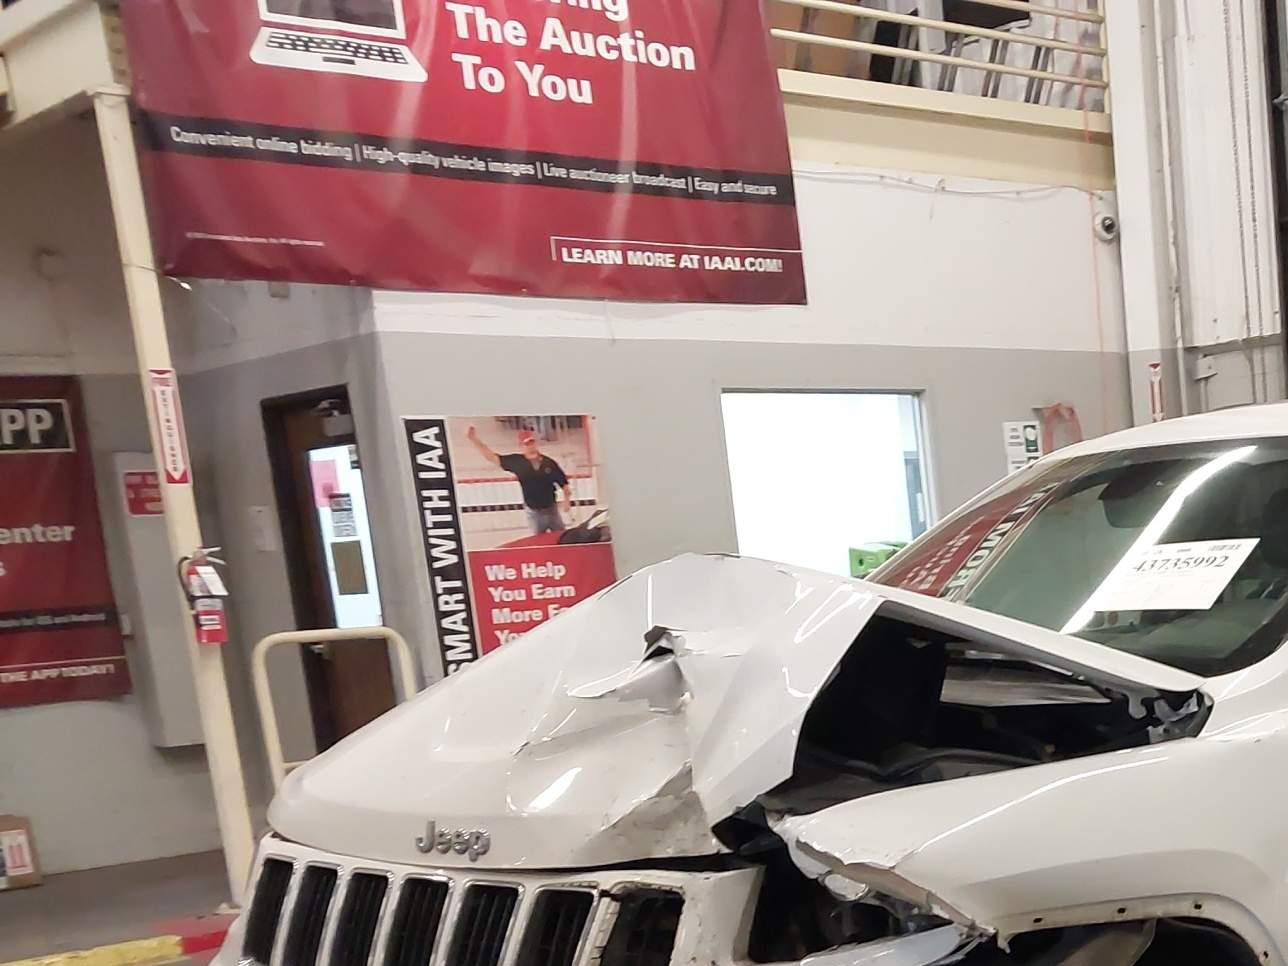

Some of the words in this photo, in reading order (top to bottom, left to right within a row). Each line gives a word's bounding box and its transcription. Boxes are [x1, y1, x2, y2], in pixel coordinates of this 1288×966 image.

[445, 2, 528, 47] The
[539, 17, 696, 71] Auction
[451, 52, 506, 93] To
[514, 60, 593, 105] You
[487, 158, 535, 177] images
[543, 162, 568, 178] Live
[694, 177, 719, 194] Easy
[561, 247, 623, 264] LEARN
[627, 250, 676, 268] MORE
[679, 254, 700, 269] AT
[703, 255, 784, 273] IAAI.COM!
[0, 408, 54, 445] PP
[412, 426, 447, 479] IAA
[420, 489, 459, 569] WITH
[484, 564, 517, 581] We
[520, 561, 567, 580] Help
[1131, 555, 1230, 573] 43735992
[487, 586, 527, 602] You
[531, 583, 576, 600] Earn
[491, 607, 543, 624] More
[415, 819, 490, 863] Jeep
